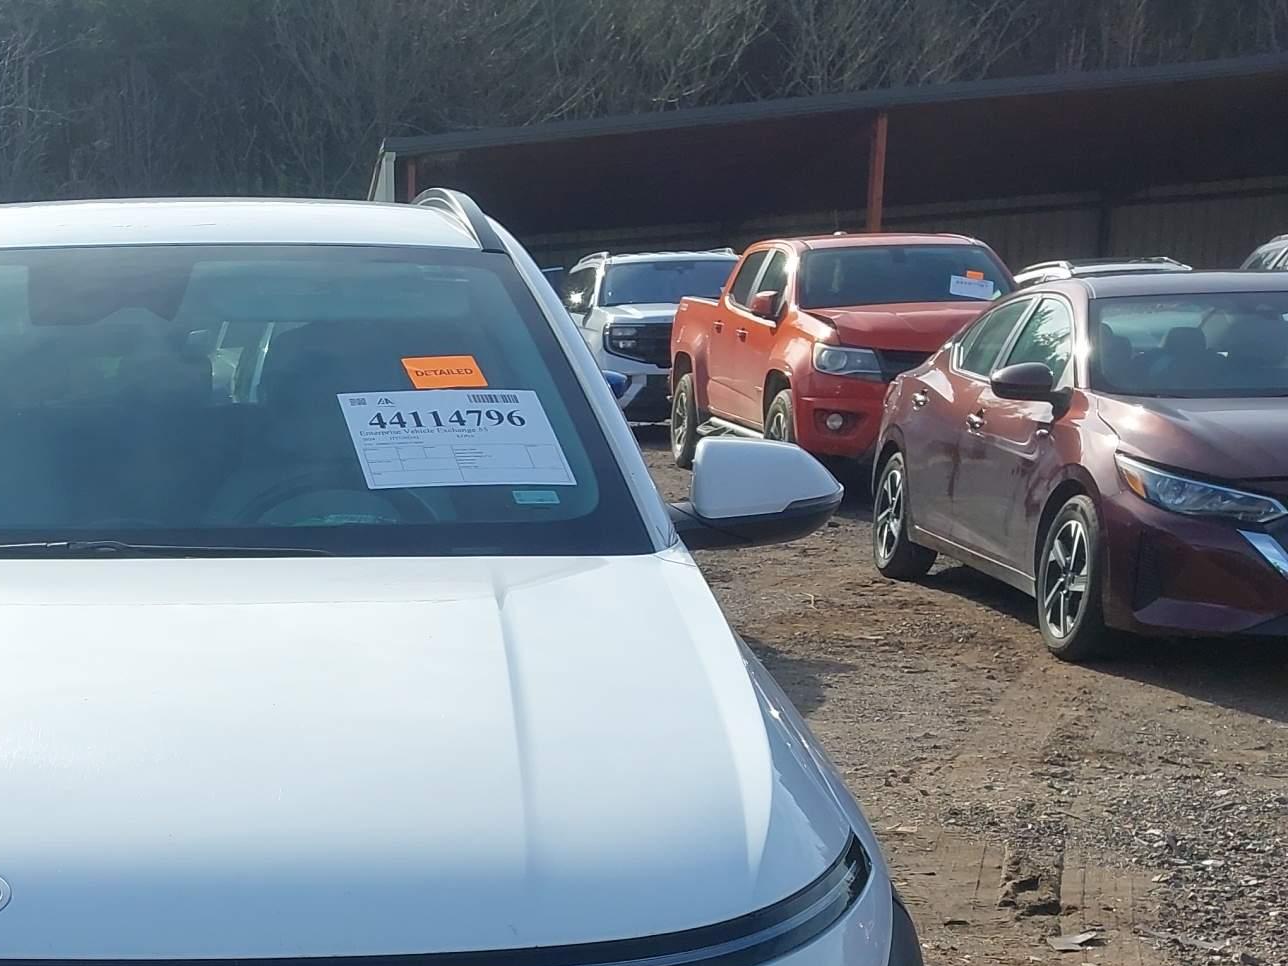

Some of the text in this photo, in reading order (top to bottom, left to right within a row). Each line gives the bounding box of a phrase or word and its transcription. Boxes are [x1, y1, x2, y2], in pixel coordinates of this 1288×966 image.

[415, 368, 473, 377] DETAILED
[369, 409, 526, 429] 44114796
[436, 426, 476, 434] Exchange
